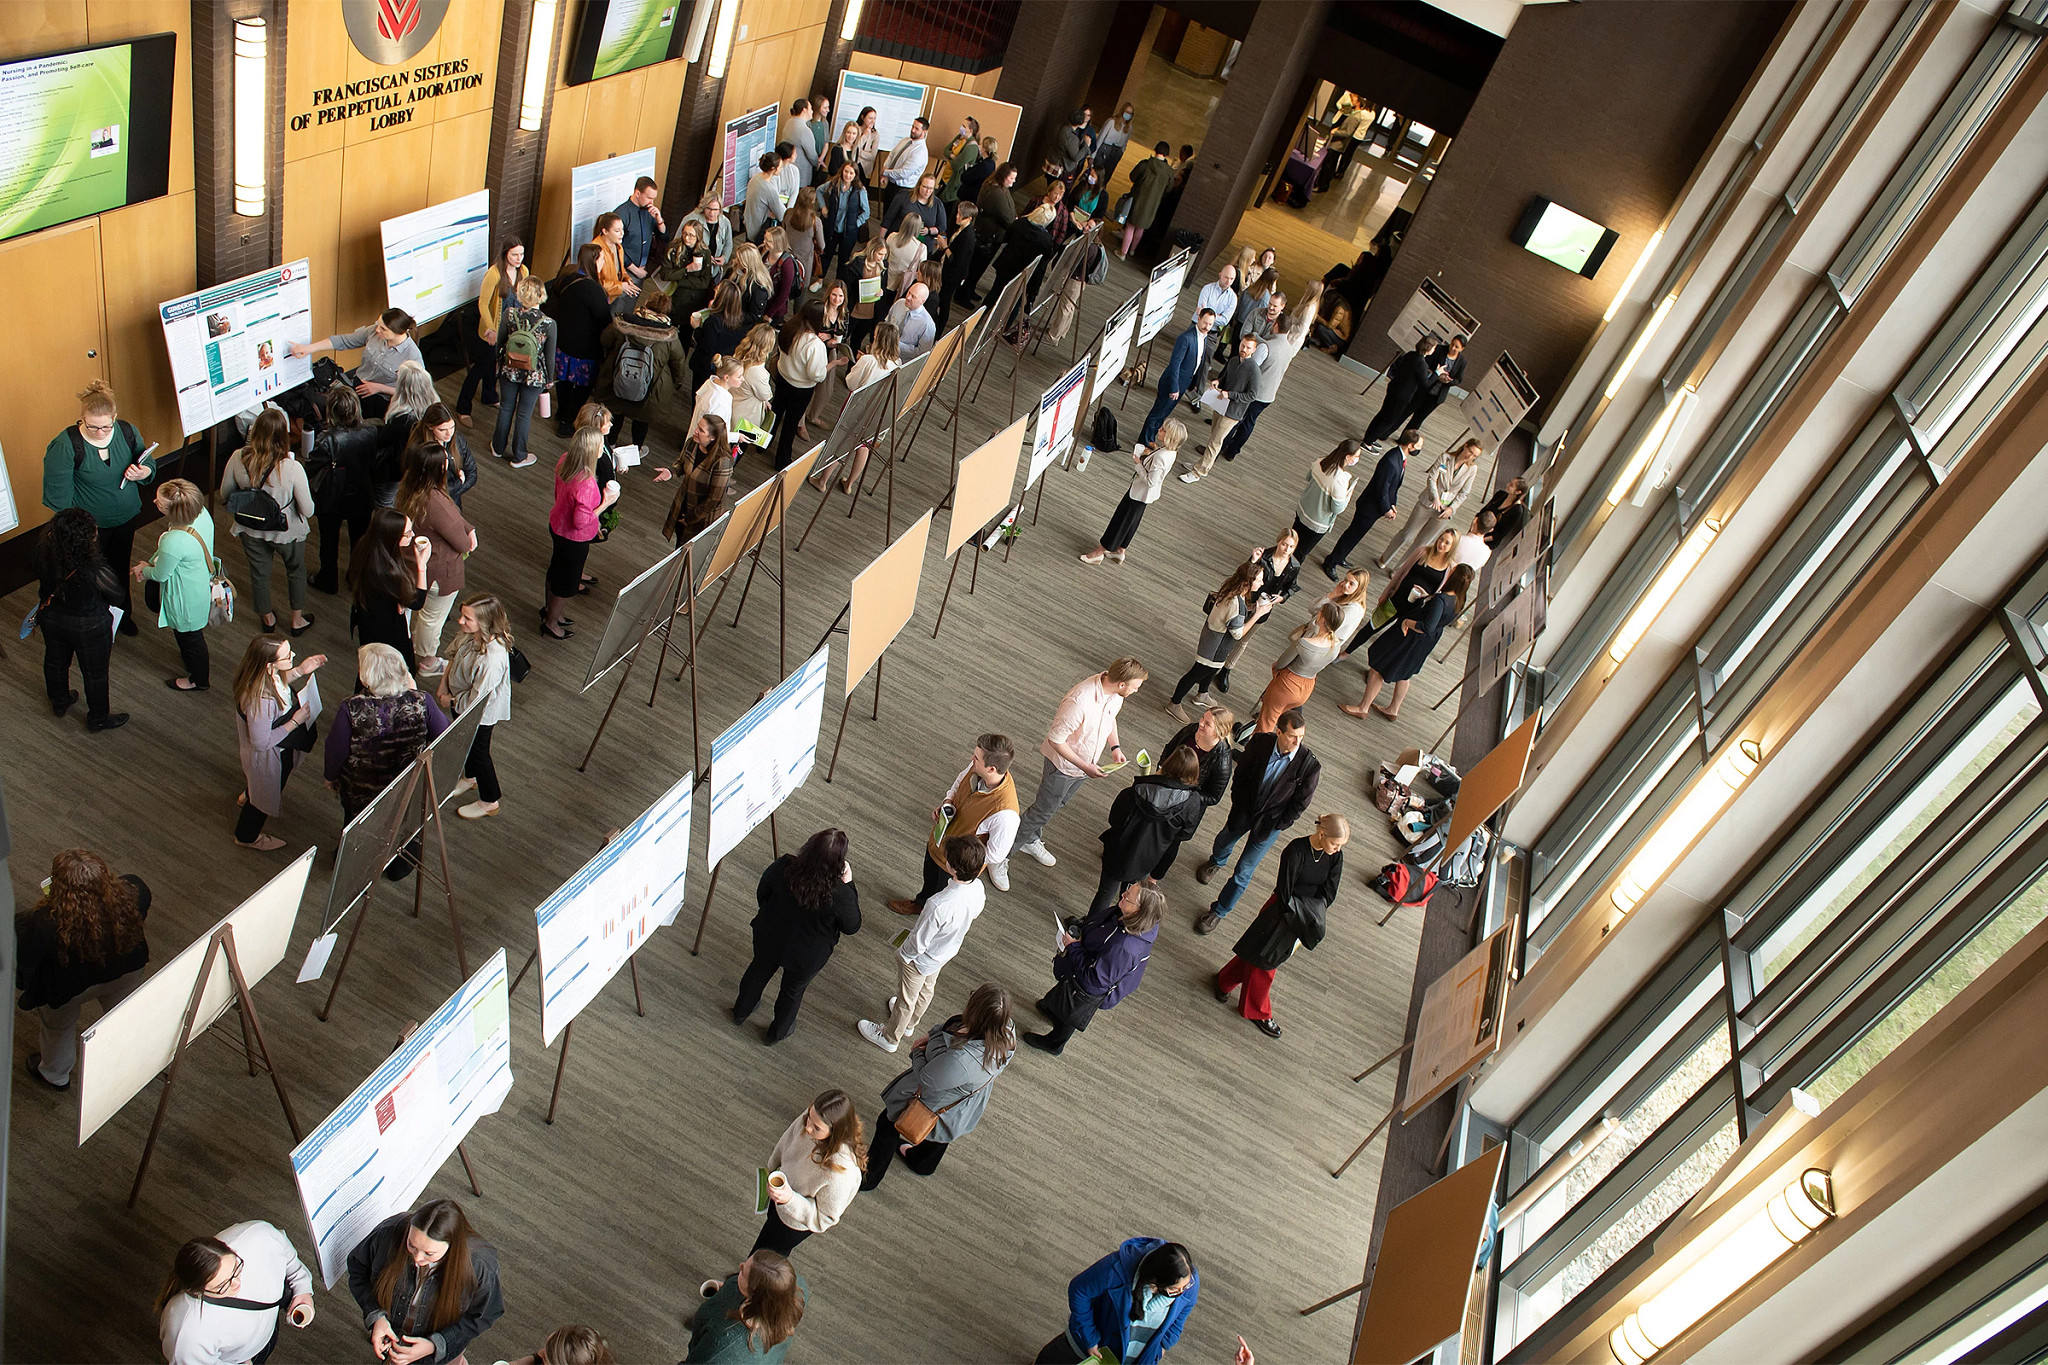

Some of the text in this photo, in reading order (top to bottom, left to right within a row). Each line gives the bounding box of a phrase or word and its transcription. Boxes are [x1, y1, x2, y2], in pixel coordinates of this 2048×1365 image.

[2, 67, 25, 75] Nursing
[38, 60, 68, 69] Pandemic:
[2, 73, 26, 82] Passion,
[40, 67, 68, 75] Promoting
[70, 62, 94, 70] Self-care
[313, 58, 469, 106] FRANCISCAN SISTERS
[290, 73, 483, 131] OF PERPETUAL ADORATION
[370, 108, 415, 132] LOBBY
[167, 299, 197, 313] GUNDERSEN
